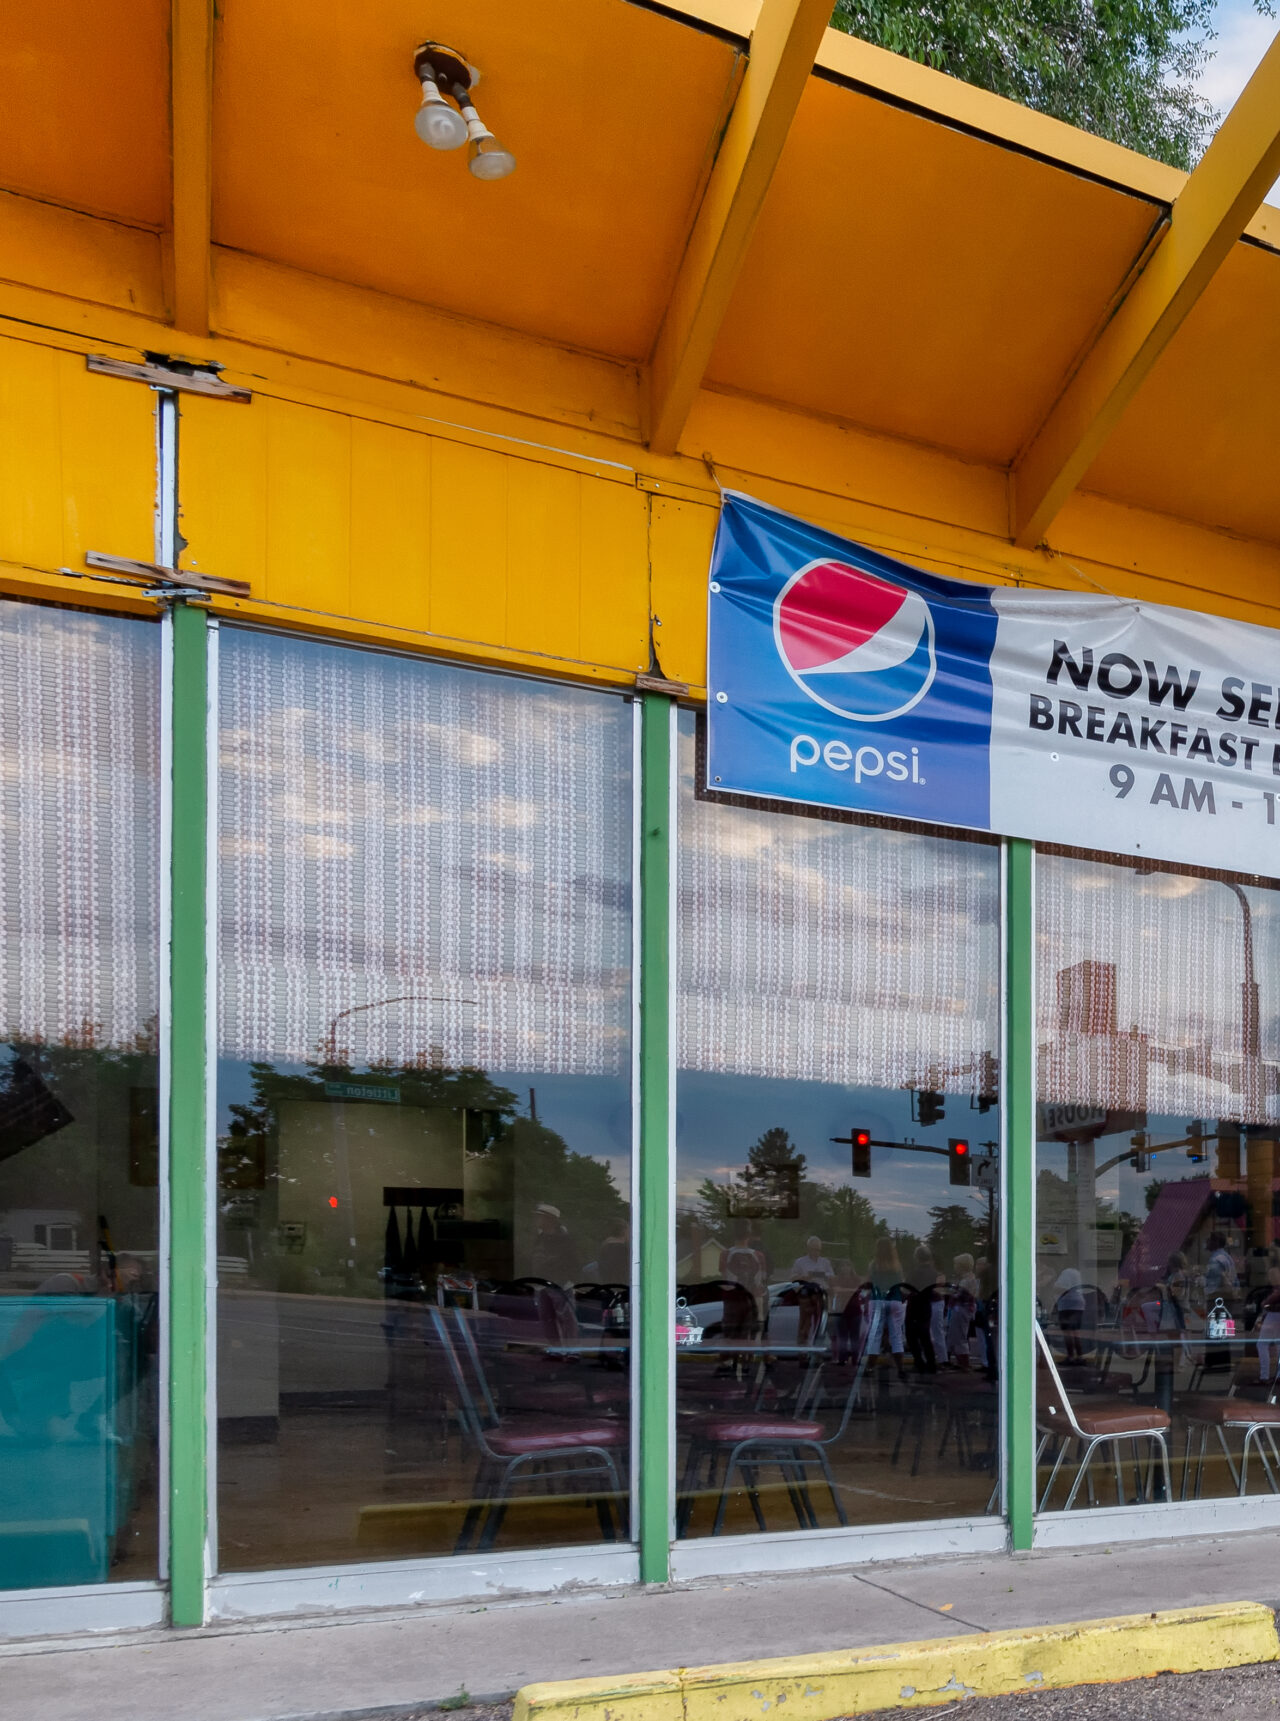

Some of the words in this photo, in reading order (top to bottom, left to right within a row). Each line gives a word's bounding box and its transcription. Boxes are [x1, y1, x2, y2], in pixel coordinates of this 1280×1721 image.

[1047, 639, 1201, 712] NOW
[790, 734, 919, 784] pepsi
[1029, 692, 1260, 771] BREAKFAST
[1109, 764, 1135, 799] 9
[1149, 773, 1217, 815] AM
